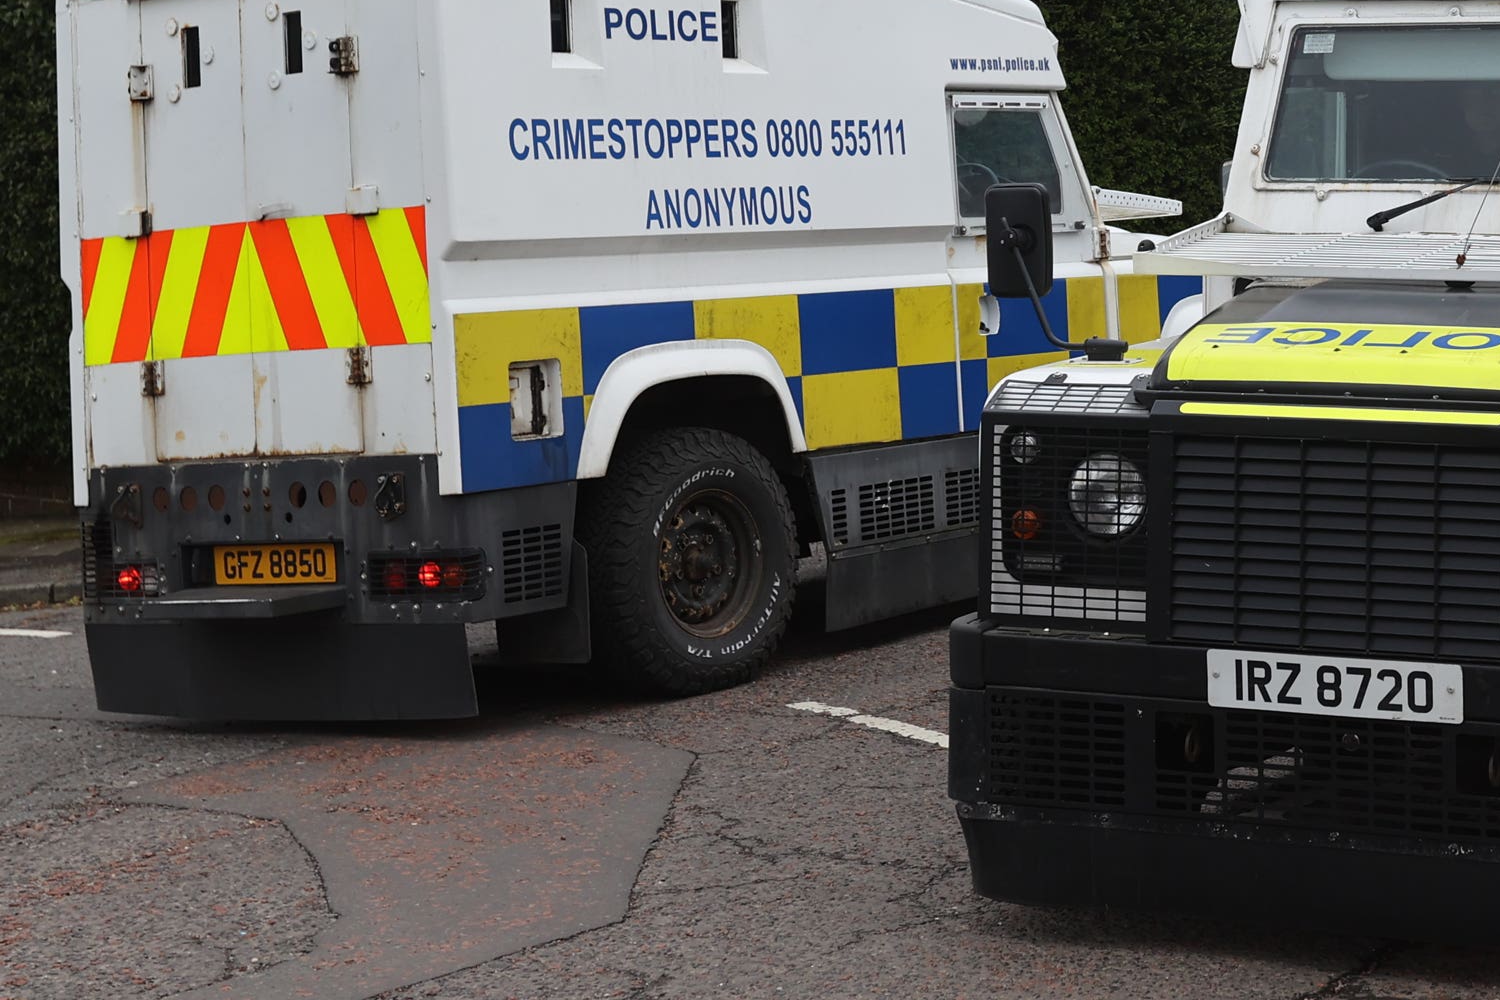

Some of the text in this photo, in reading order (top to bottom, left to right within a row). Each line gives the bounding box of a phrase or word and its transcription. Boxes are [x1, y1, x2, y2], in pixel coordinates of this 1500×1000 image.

[604, 7, 718, 42] POLICE
[950, 56, 1050, 72] www.psni.police.uk
[508, 117, 907, 161] CRIMESTOPPERS 0800 555111
[645, 185, 812, 230] ANONYMOUS
[223, 548, 327, 580] GFZ 8850
[1234, 658, 1434, 714] IRZ 8720
